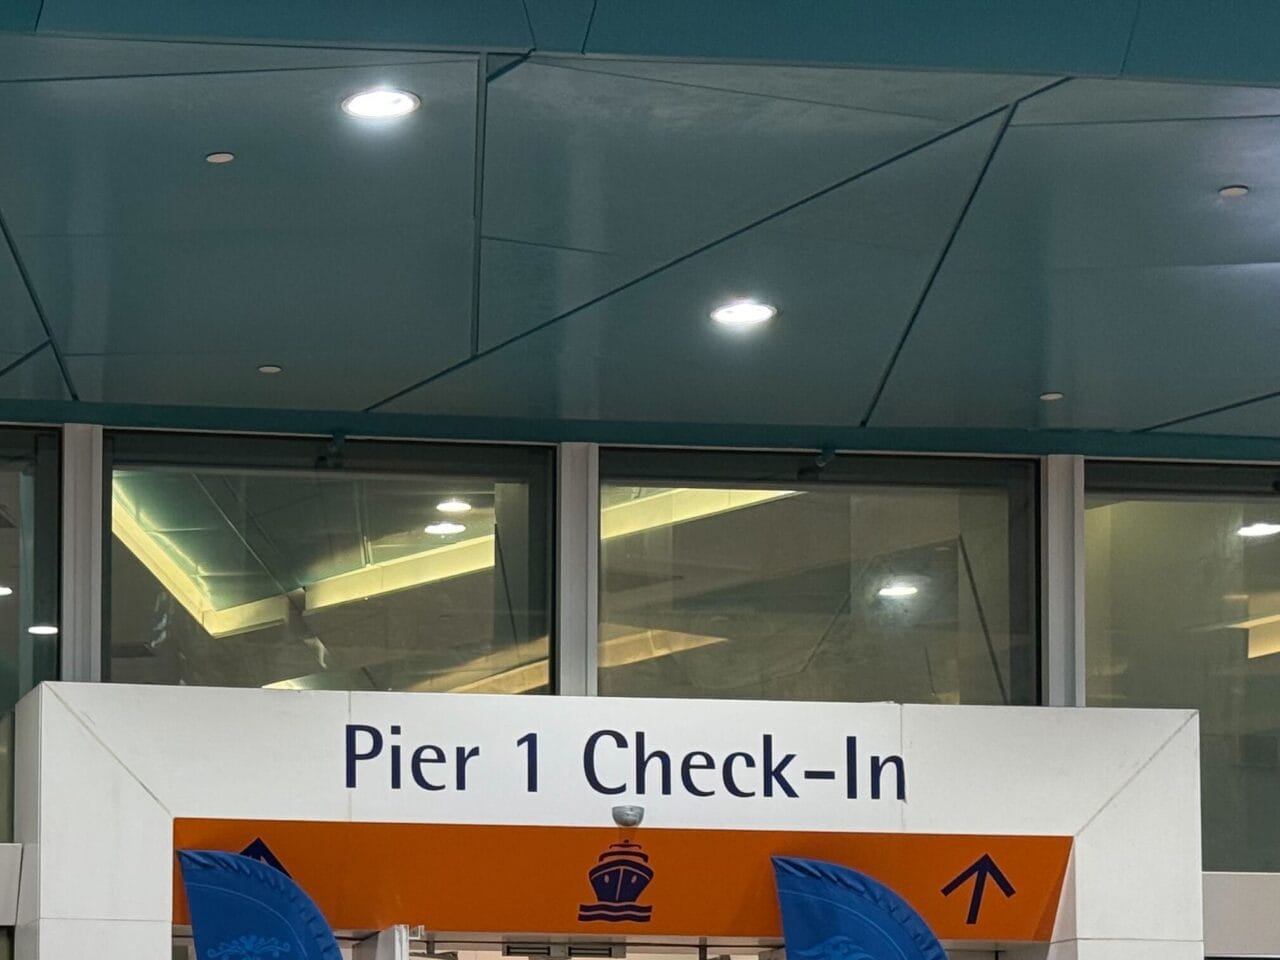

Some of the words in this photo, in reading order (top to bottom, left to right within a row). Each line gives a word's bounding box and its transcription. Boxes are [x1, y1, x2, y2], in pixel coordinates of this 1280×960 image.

[344, 723, 481, 793] Pier
[516, 731, 540, 793] 1
[582, 728, 907, 801] Check-In
